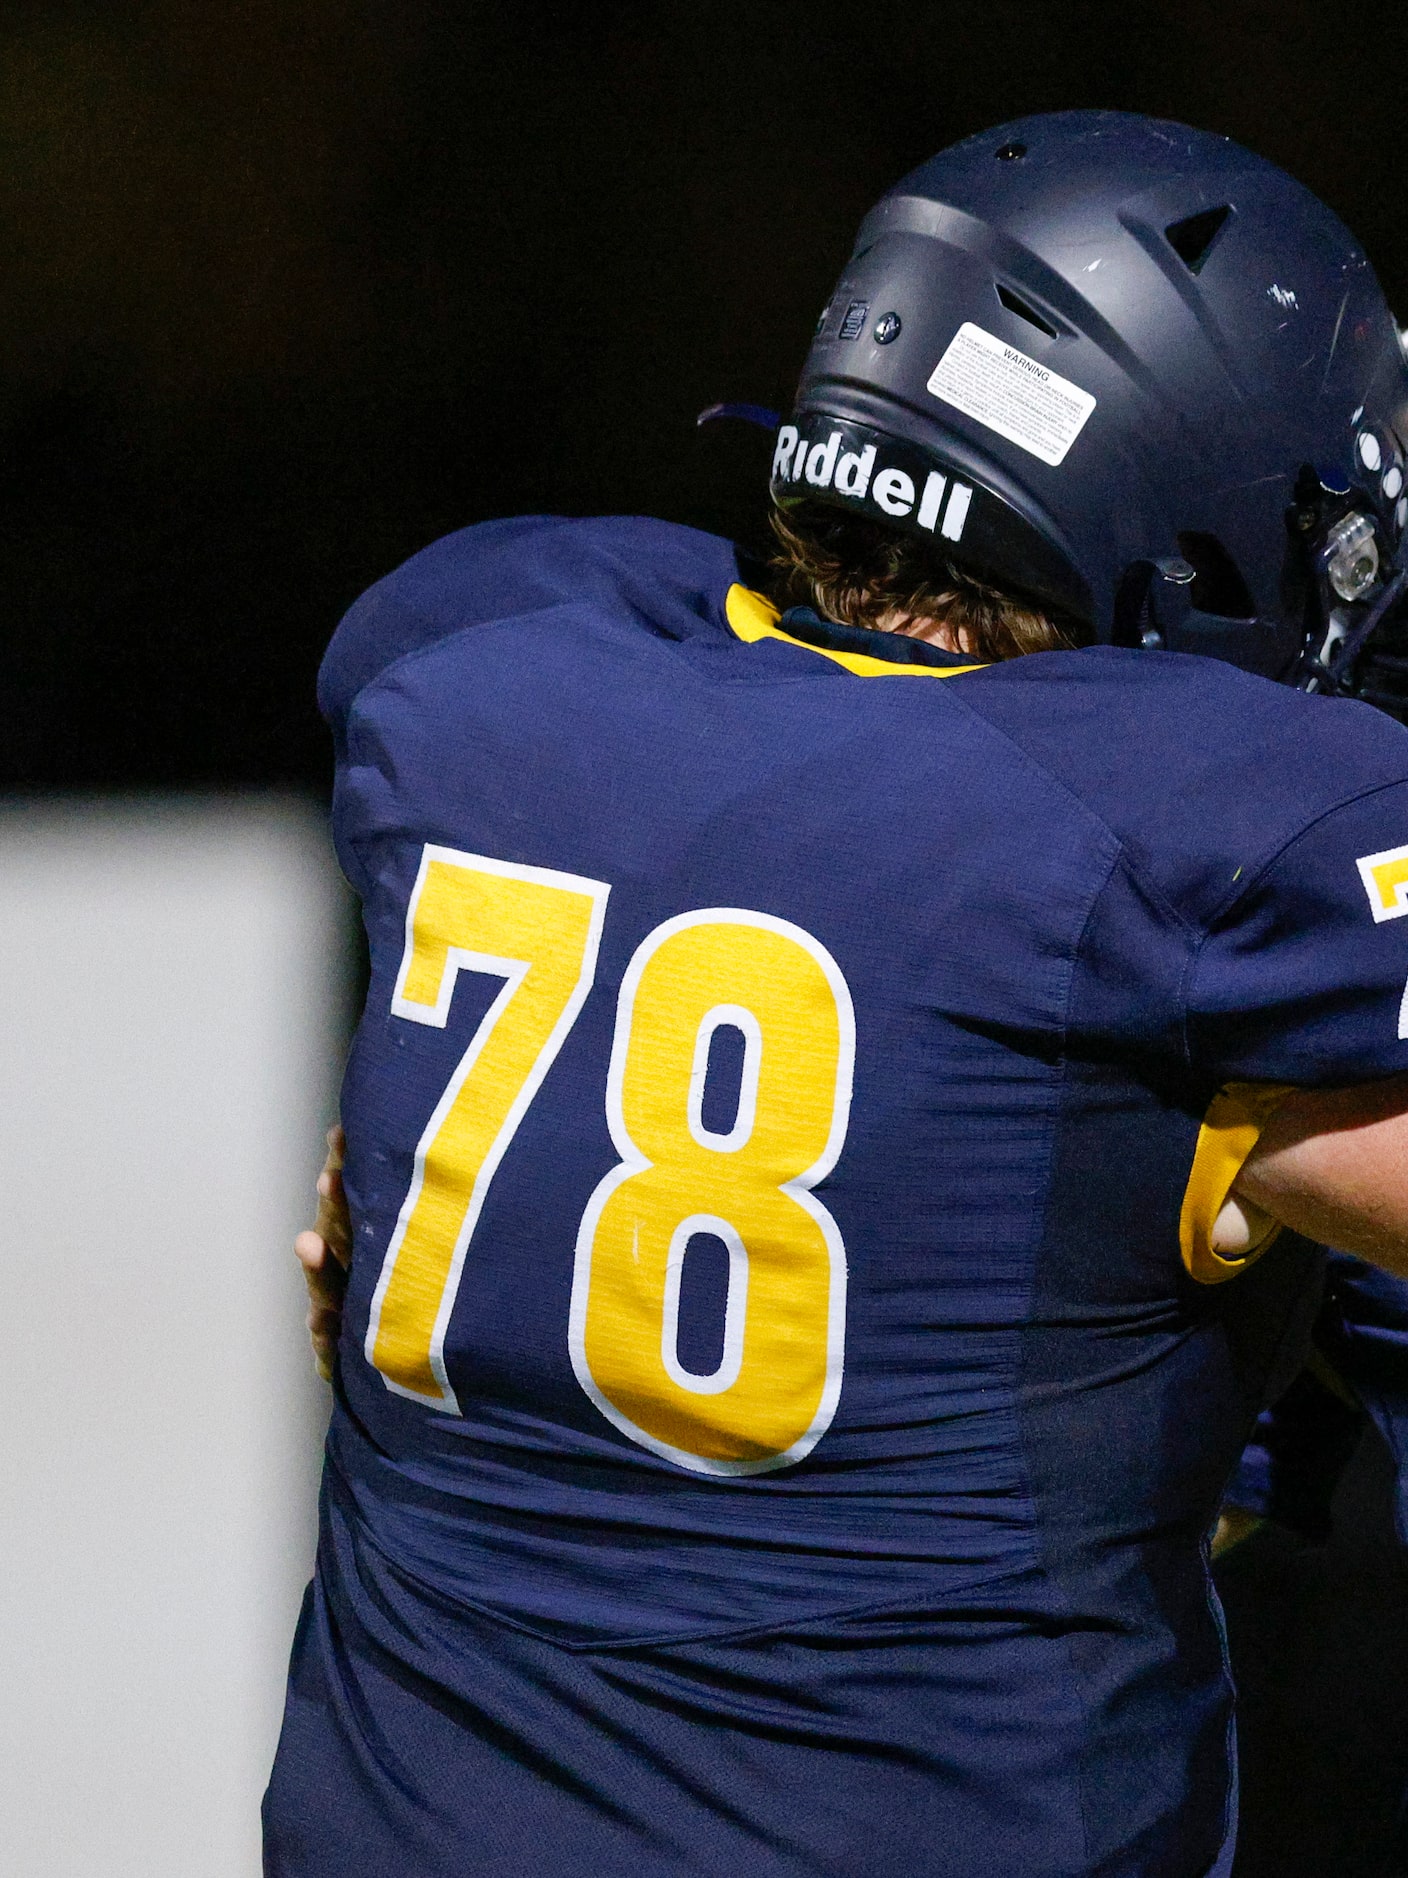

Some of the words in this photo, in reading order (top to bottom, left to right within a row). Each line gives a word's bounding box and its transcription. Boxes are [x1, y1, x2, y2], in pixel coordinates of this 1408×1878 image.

[1003, 348, 1050, 381] WARNING
[771, 425, 973, 543] Riddell
[364, 842, 857, 1477] 78
